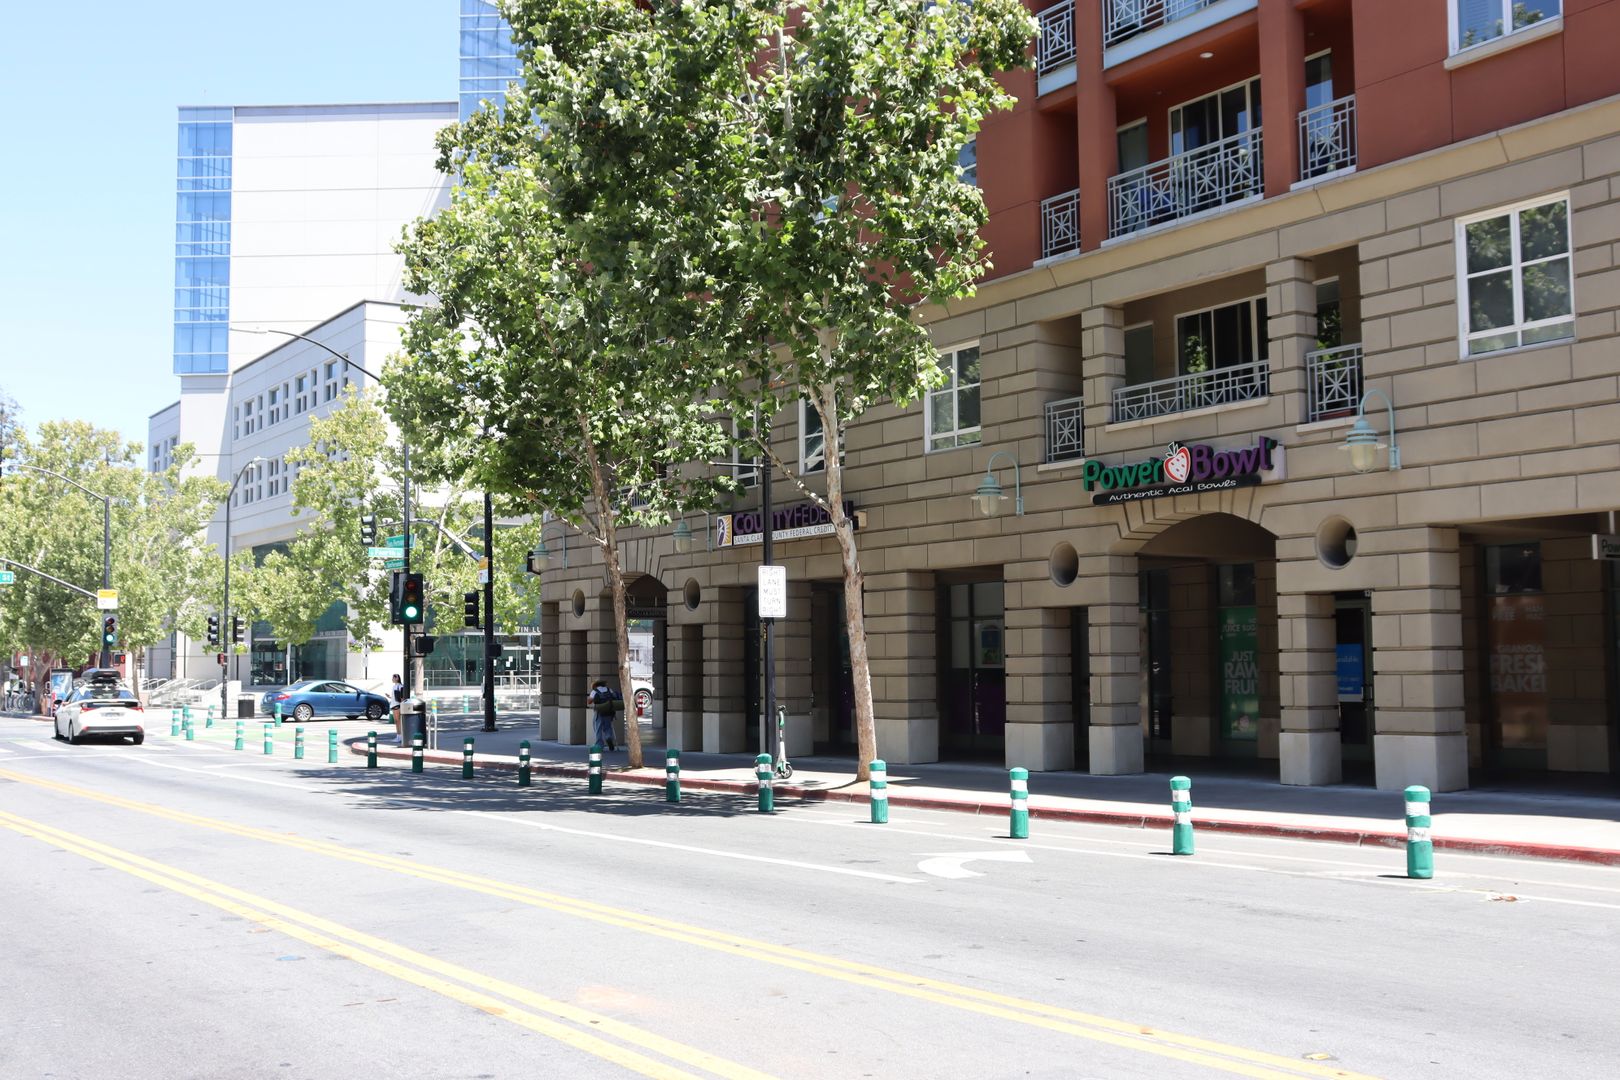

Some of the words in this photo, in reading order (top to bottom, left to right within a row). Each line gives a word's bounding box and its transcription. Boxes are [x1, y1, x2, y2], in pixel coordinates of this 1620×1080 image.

[1083, 458, 1164, 491] Power
[1191, 436, 1271, 480] Bowl
[789, 527, 813, 537] FEDERAL
[814, 524, 832, 534] CREDIT
[1231, 650, 1255, 662] JUST
